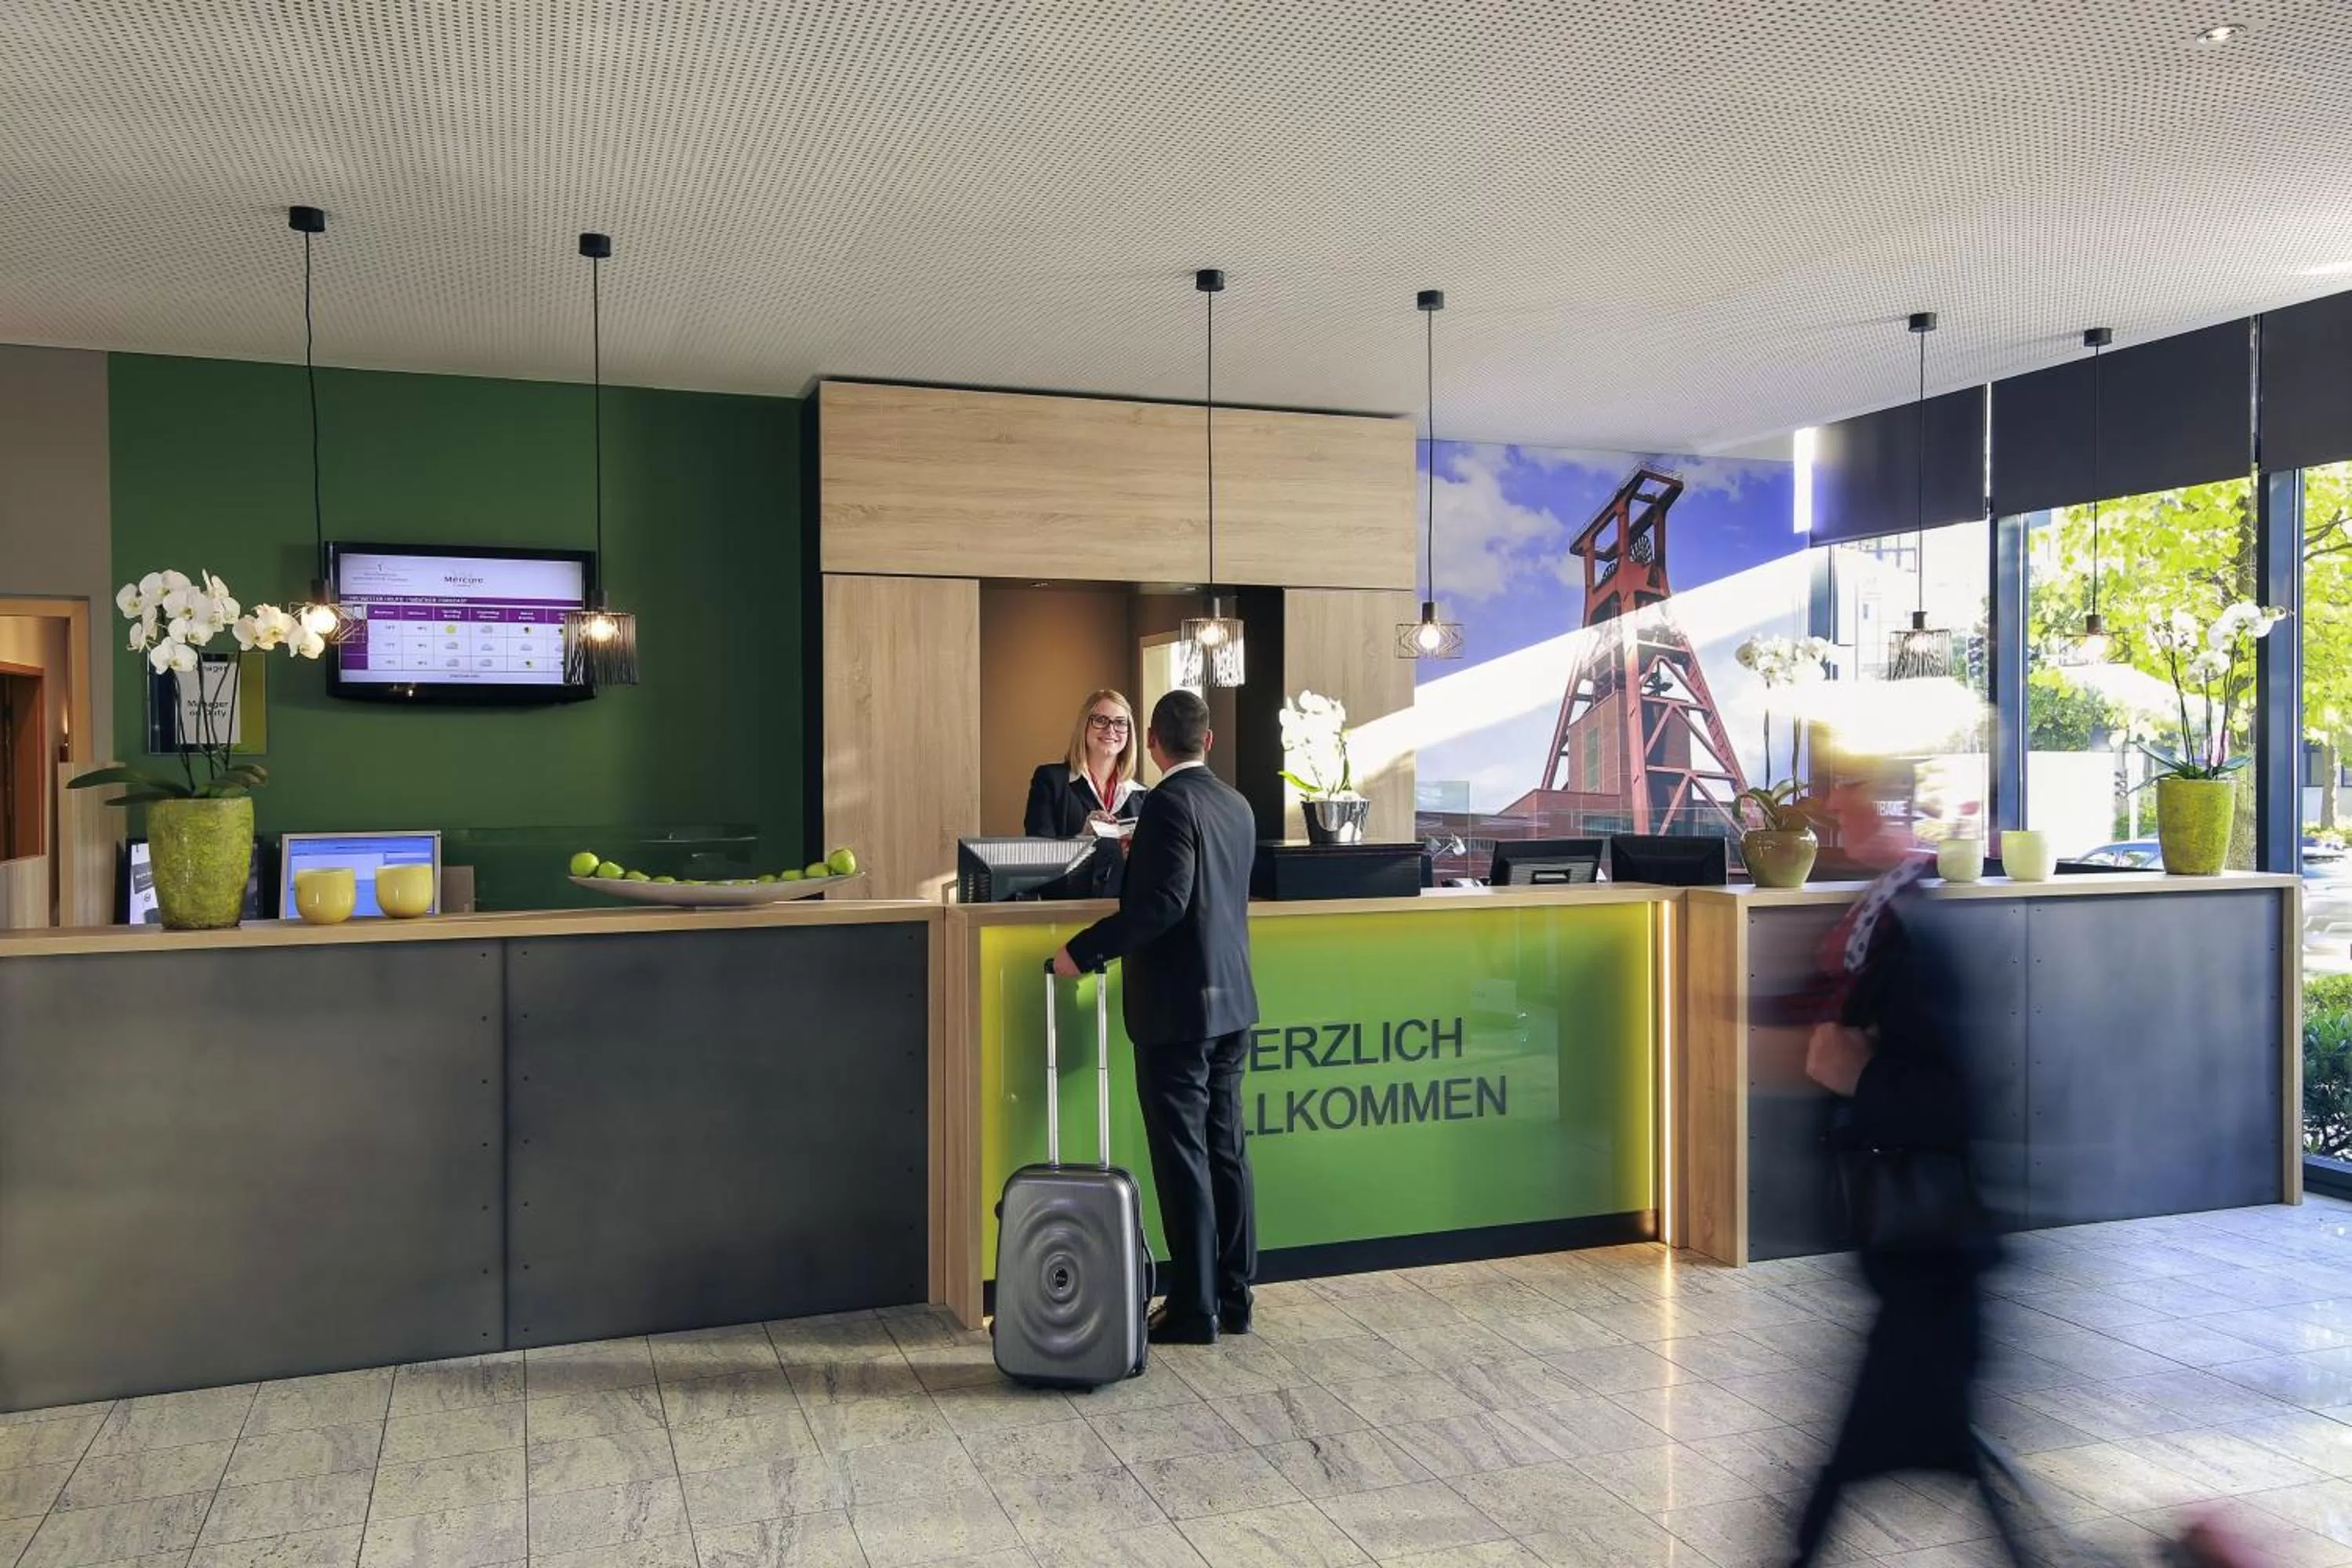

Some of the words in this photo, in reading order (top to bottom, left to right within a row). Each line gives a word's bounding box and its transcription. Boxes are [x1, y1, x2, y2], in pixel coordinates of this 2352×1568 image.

[444, 575, 484, 584] Mercure
[187, 700, 228, 709] Mnager
[1250, 1017, 1462, 1073] ERZLICH
[1245, 1075, 1507, 1136] LKOMMEN
